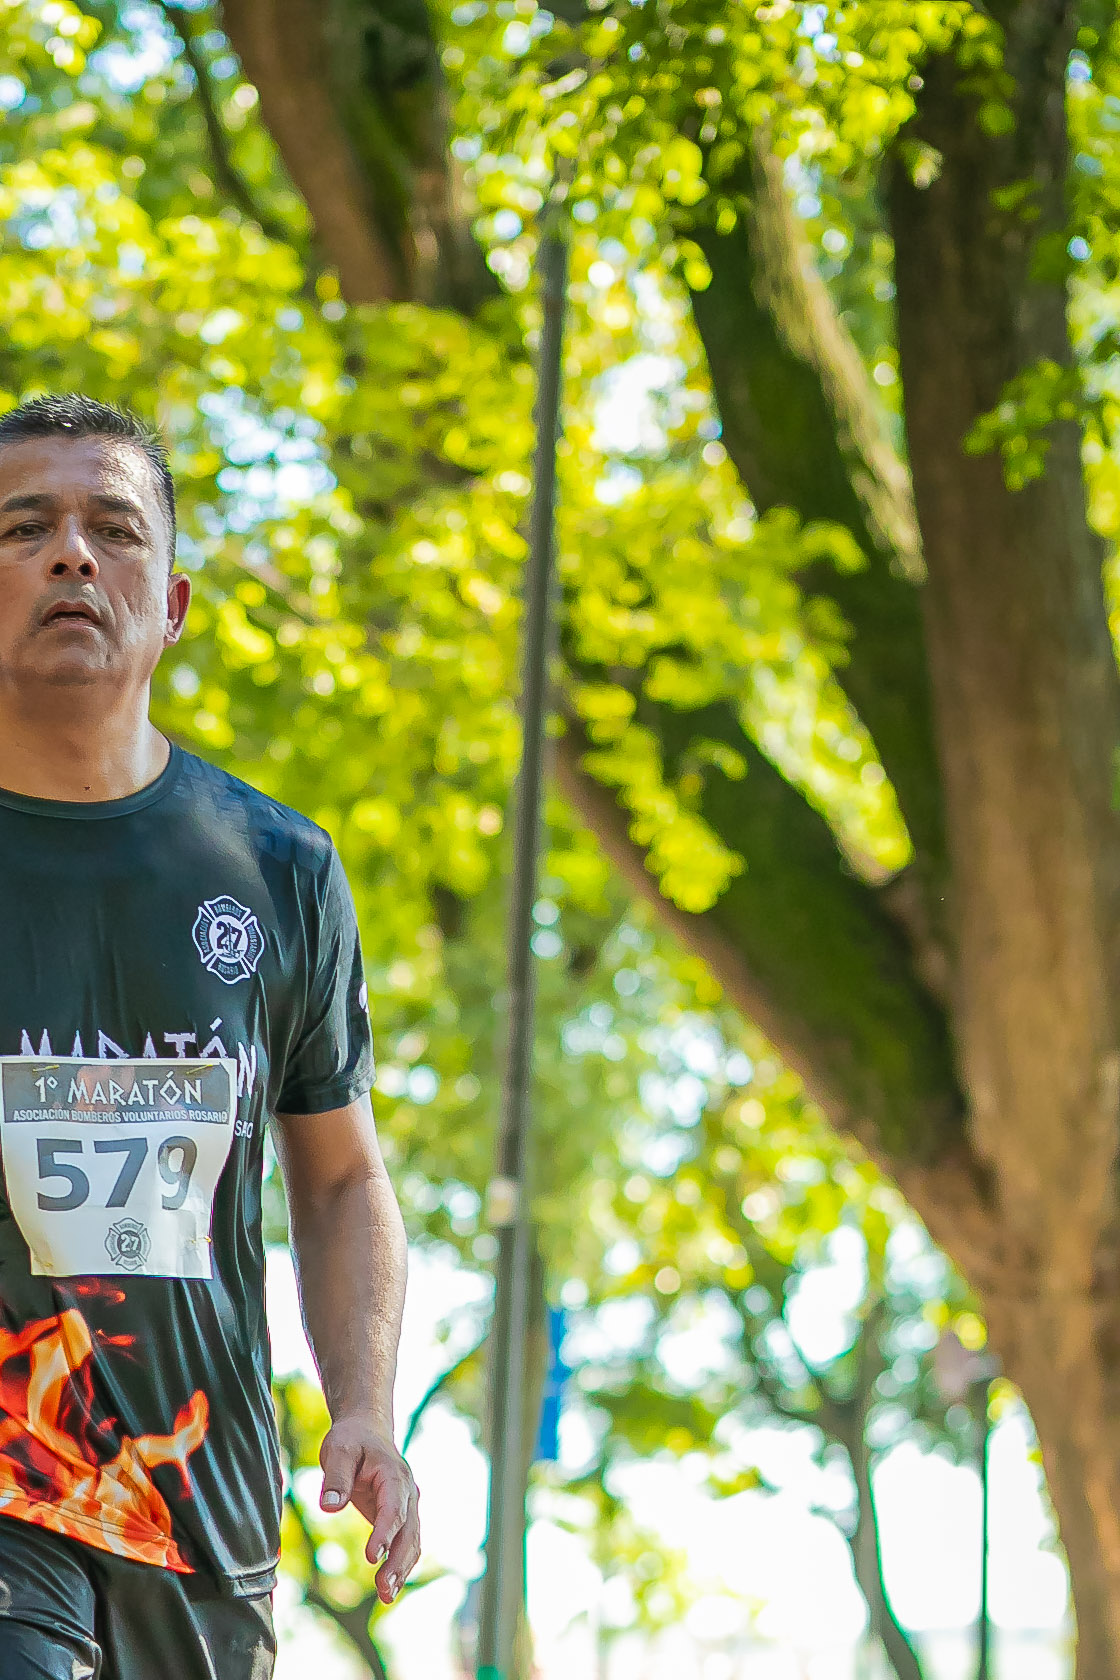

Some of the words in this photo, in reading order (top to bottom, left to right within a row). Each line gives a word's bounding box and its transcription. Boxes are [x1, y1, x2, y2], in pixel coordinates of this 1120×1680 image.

[216, 920, 243, 950] 27
[68, 1070, 202, 1107] MARATÓN
[71, 1110, 121, 1123] BOMBEROS
[123, 1110, 187, 1122] VOLUNTARIOS
[189, 1110, 228, 1123] ROSARIO
[37, 1135, 198, 1212] 579
[120, 1233, 140, 1252] 27
